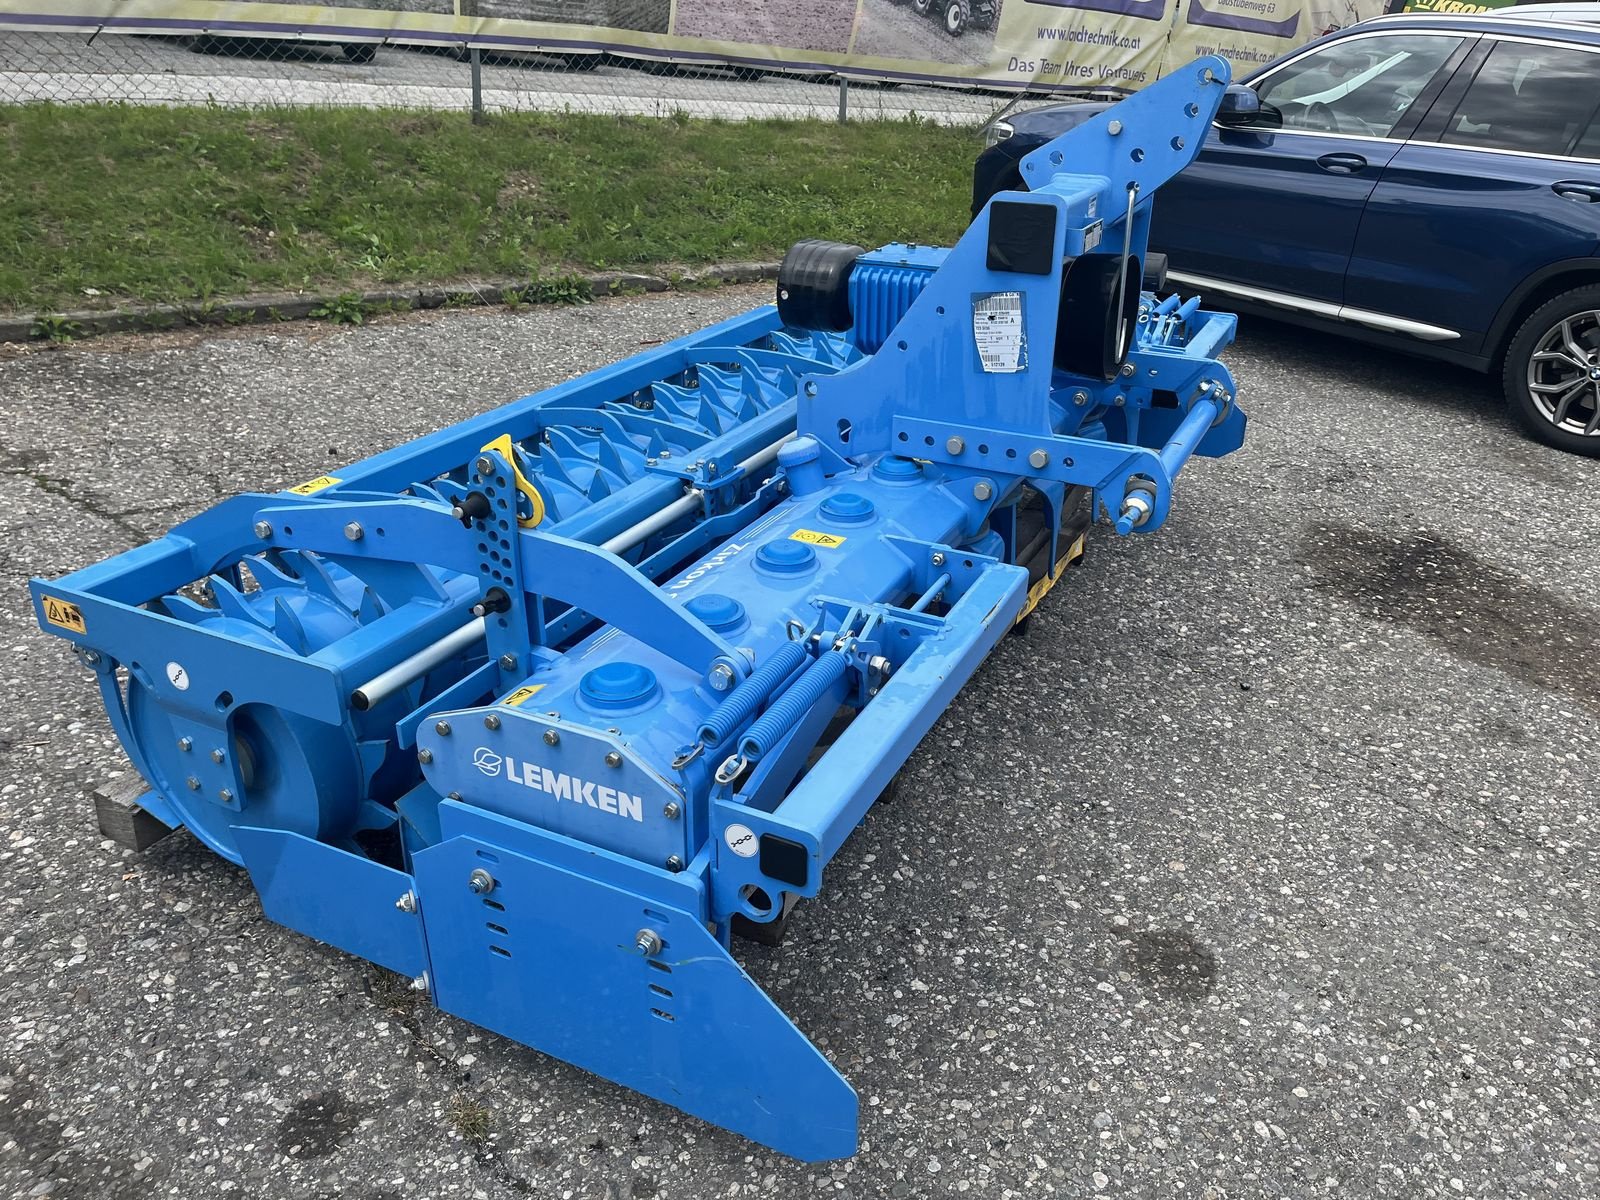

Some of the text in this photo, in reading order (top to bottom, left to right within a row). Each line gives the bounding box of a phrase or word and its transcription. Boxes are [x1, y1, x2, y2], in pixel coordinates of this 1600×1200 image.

[1266, 3, 1276, 13] 63
[1433, 0, 1493, 15] KRON
[1195, 42, 1276, 63] wwwlandtechnik.co.at
[1007, 57, 1035, 72] Das
[1040, 59, 1061, 75] Team
[1064, 61, 1094, 78] Ihres
[671, 543, 750, 590] Zirkon
[506, 757, 643, 823] LEMKEN
